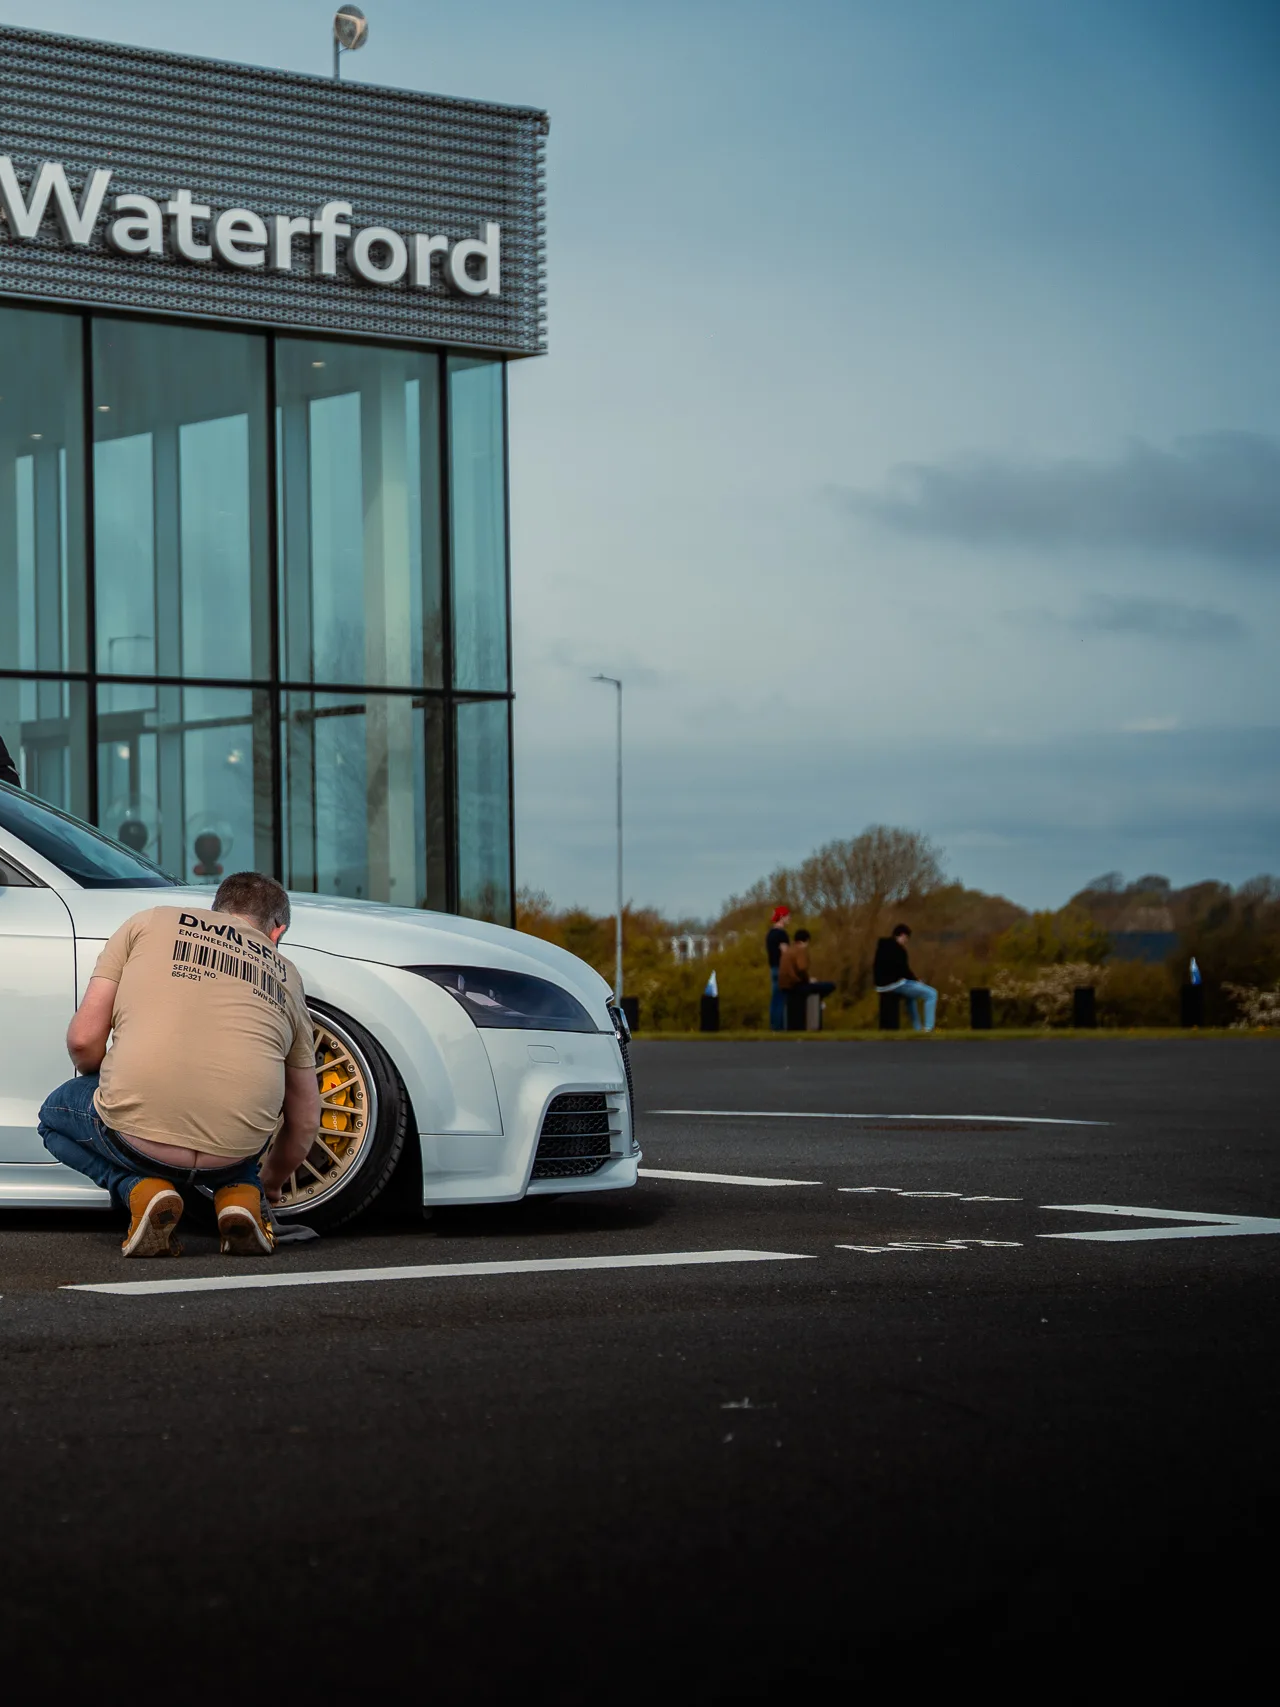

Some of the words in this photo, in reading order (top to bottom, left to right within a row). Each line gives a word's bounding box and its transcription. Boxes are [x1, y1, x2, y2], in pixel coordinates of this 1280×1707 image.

[179, 913, 243, 946] DWN
[179, 929, 240, 953] ENGINEERED
[243, 950, 259, 963] FOR
[172, 971, 201, 981] 654-321
[173, 964, 201, 974] SERIAL
[204, 970, 218, 979] NO.
[253, 988, 268, 1001] DWN
